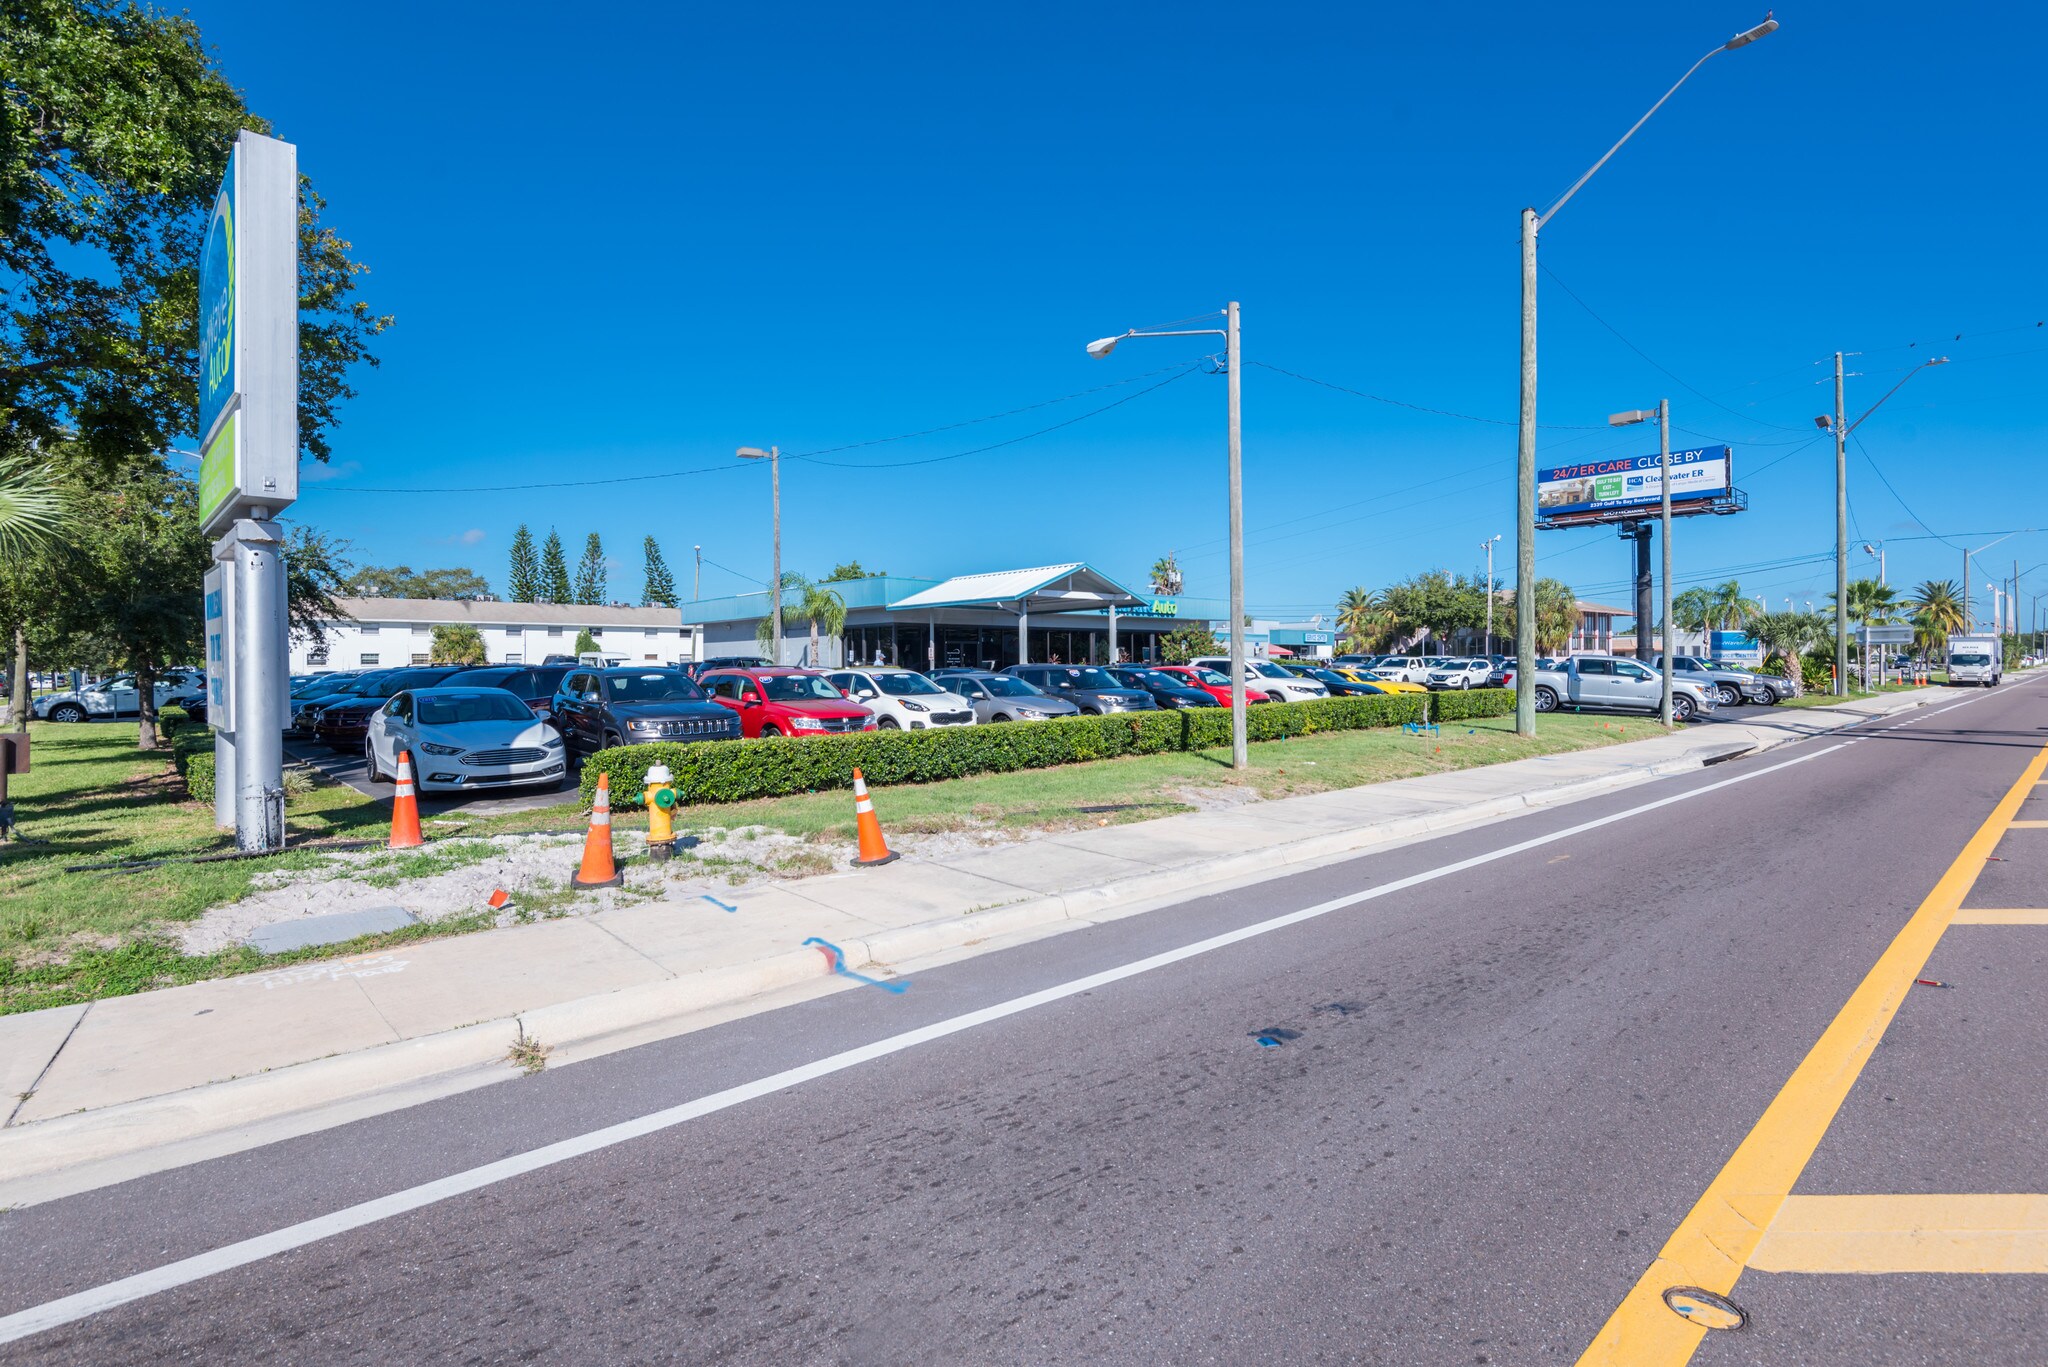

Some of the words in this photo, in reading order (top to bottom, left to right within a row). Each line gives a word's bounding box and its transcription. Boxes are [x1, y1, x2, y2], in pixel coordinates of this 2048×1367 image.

[208, 336, 228, 402] Auto
[1553, 467, 1577, 480] 24/7
[1580, 465, 1595, 476] ER
[1597, 459, 1632, 473] CARE
[1637, 453, 1682, 468] CLOSE
[1685, 449, 1703, 462] BY
[1628, 476, 1642, 484] HCA
[1692, 469, 1704, 477] ER
[1152, 600, 1177, 614] Auto
